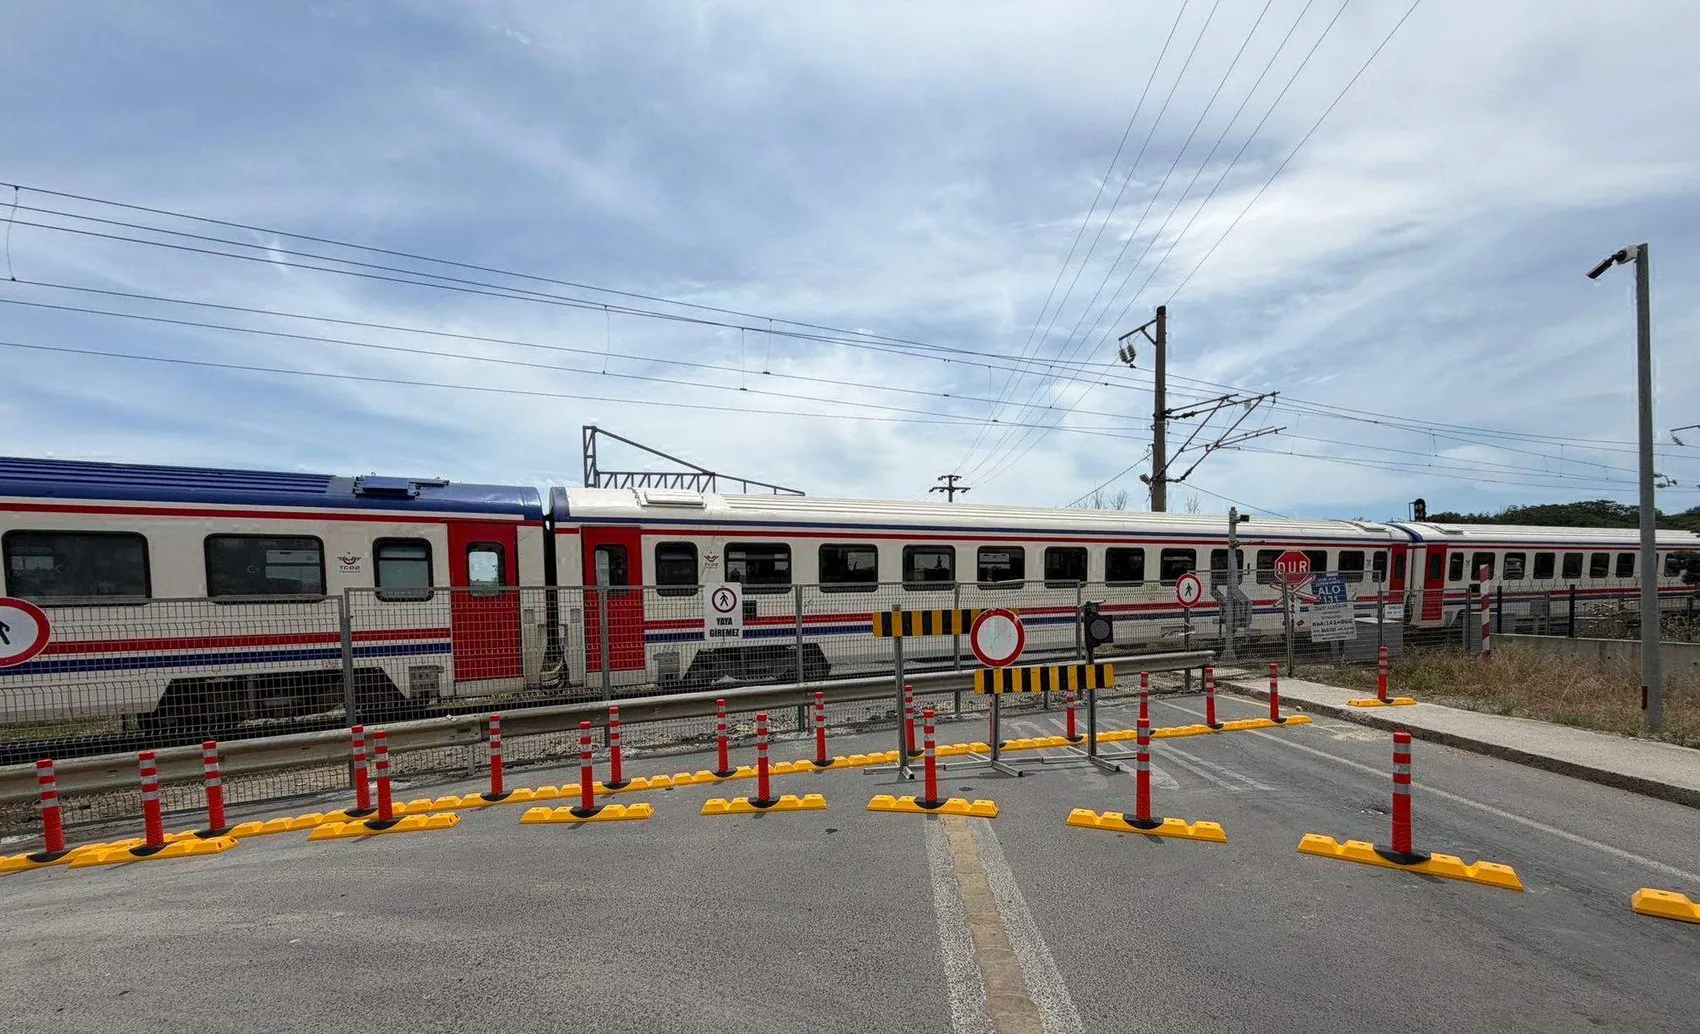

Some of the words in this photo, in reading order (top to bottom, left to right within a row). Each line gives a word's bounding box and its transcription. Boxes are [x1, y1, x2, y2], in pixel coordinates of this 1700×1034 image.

[1277, 560, 1307, 575] DUR
[1318, 585, 1341, 596] ALO
[716, 617, 733, 626] YAYA
[709, 627, 740, 638] GİREMEZ
